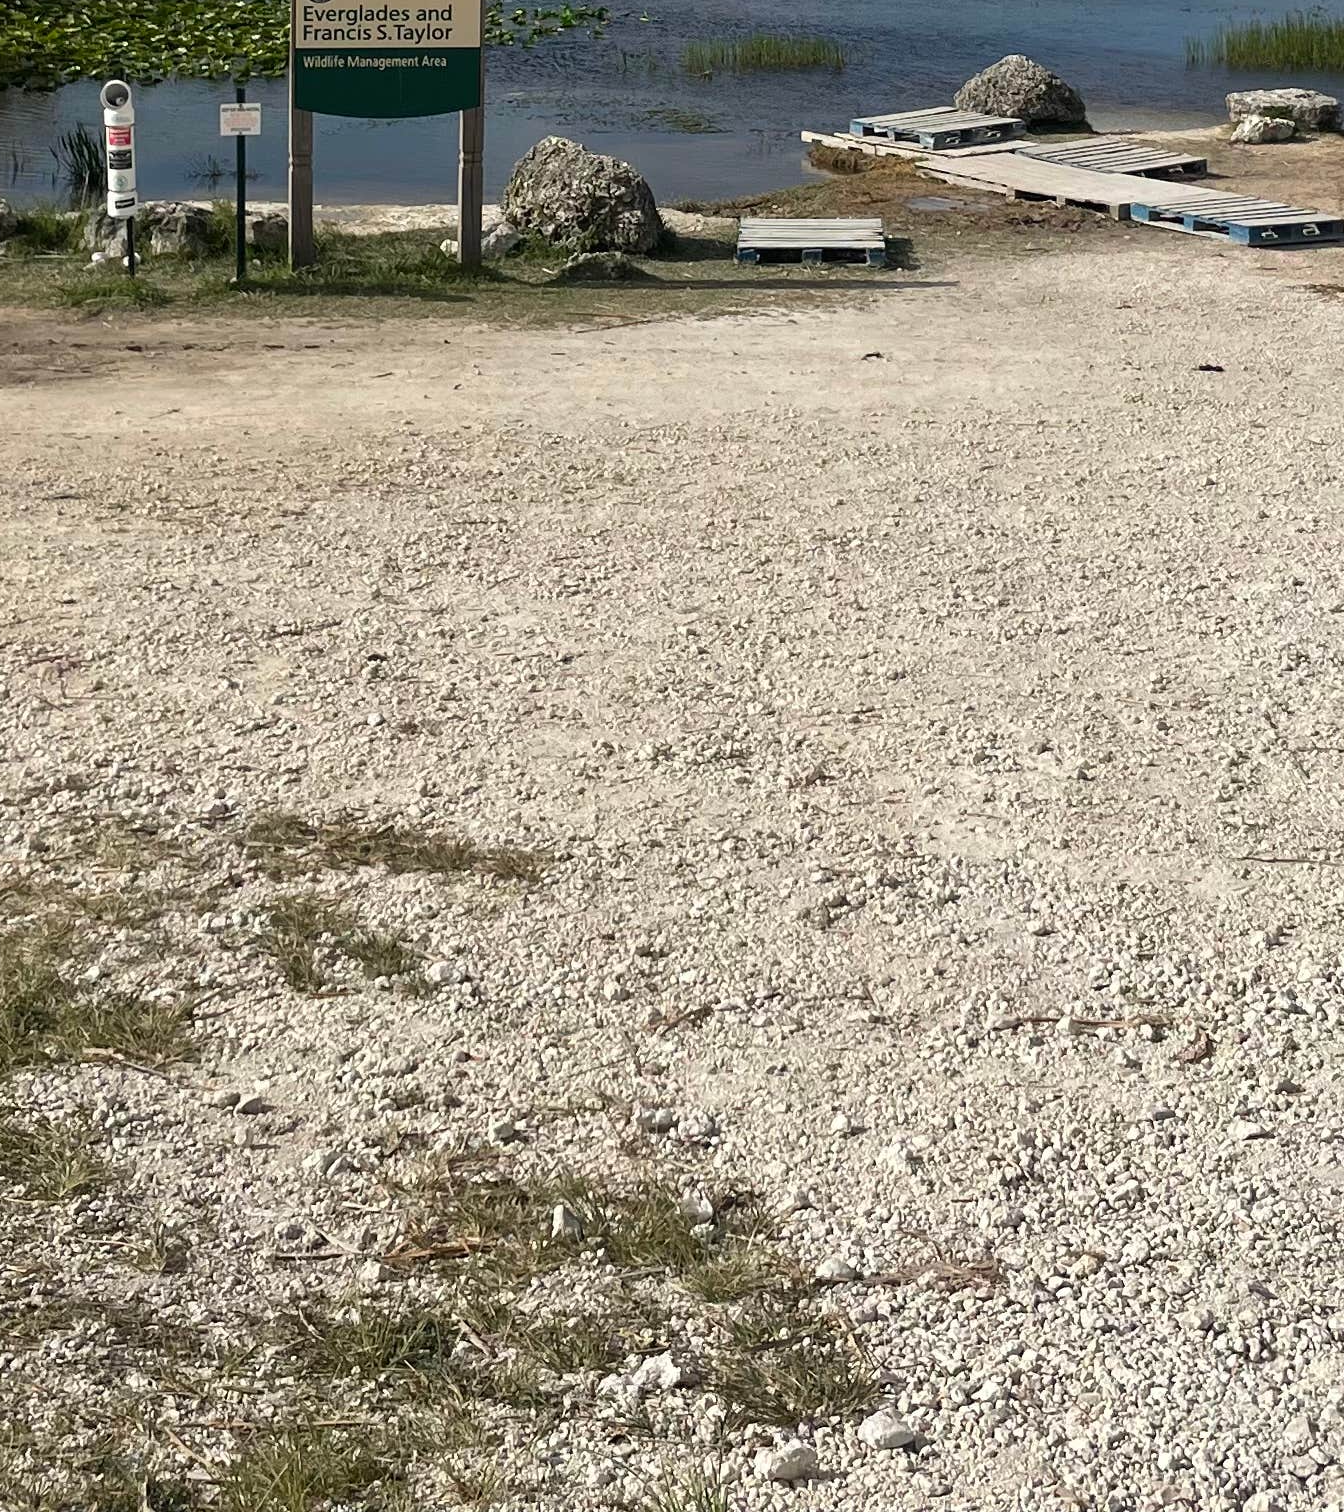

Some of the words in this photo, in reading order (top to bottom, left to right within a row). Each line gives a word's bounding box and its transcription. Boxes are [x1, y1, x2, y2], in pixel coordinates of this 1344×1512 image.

[304, 5, 410, 26] Everglades
[416, 5, 452, 21] and
[304, 25, 372, 40] Francis
[376, 25, 393, 41] S.
[393, 23, 453, 45] Taylor
[303, 55, 344, 68] Wildlife
[347, 56, 419, 71] Management
[421, 56, 447, 67] Area
